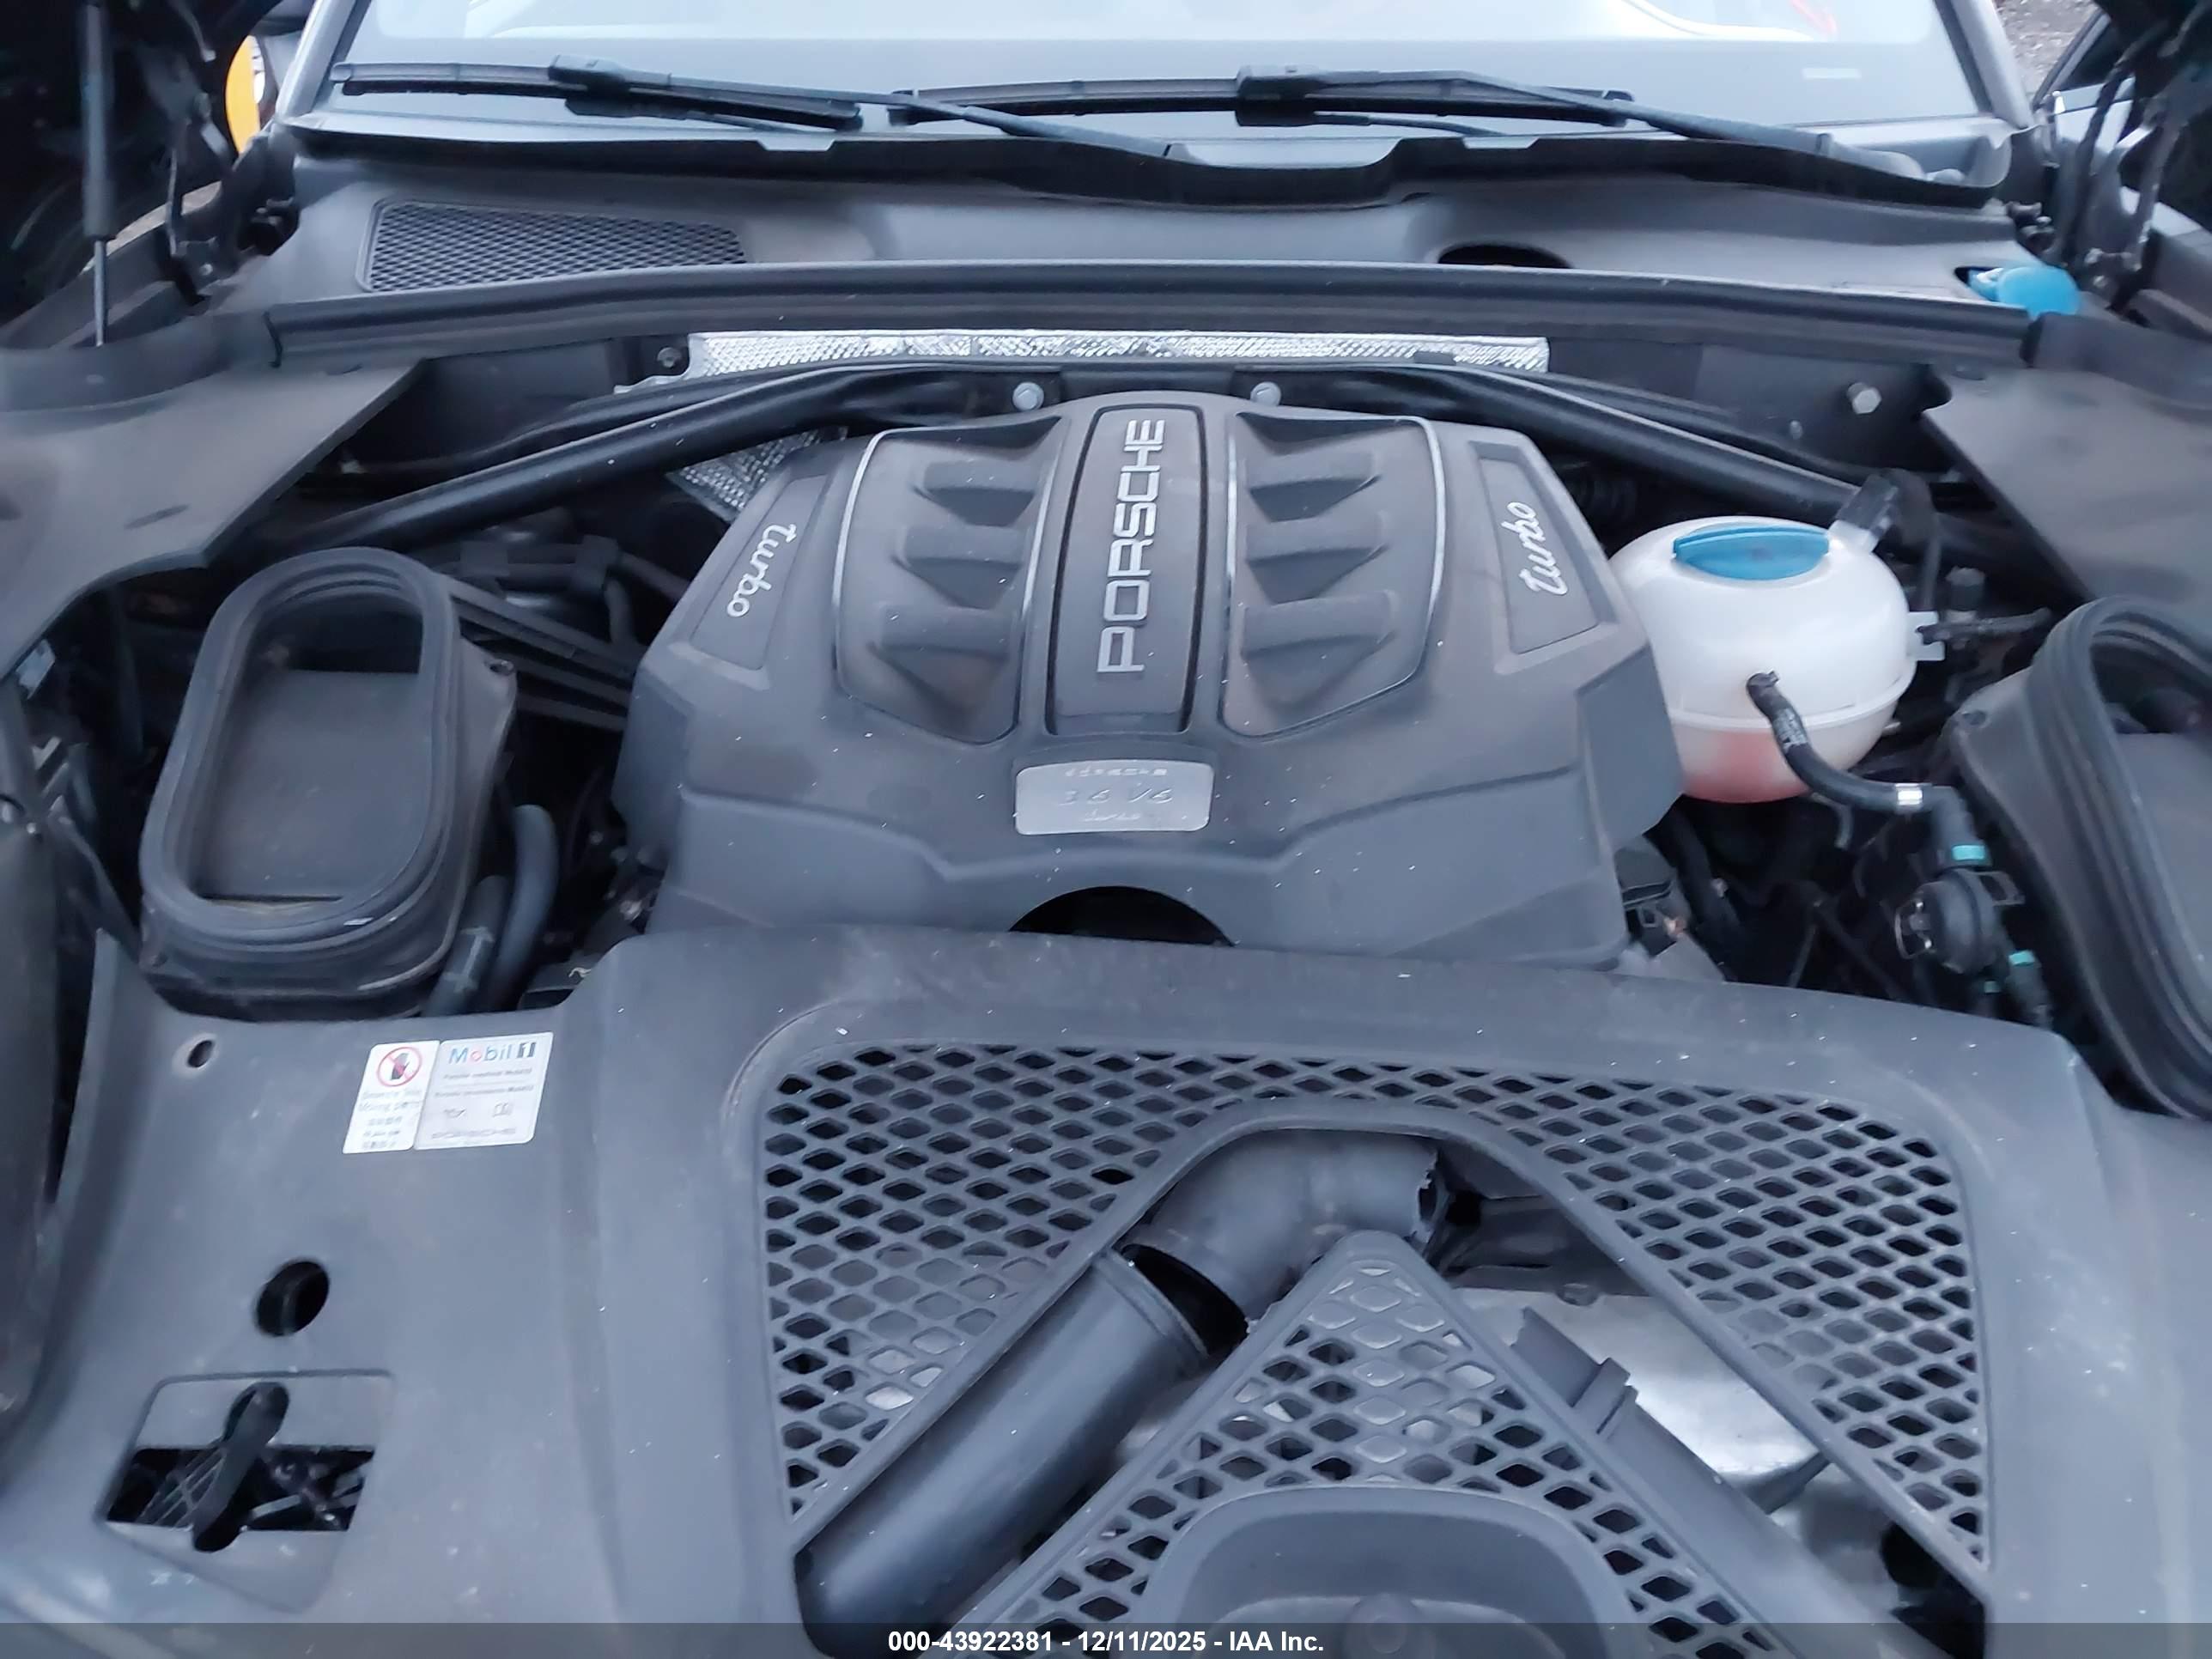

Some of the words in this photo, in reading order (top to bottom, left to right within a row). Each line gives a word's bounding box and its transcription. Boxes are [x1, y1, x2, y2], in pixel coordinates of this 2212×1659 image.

[726, 523, 797, 617] turbo
[1097, 419, 1165, 672] PORSCHE
[1501, 501, 1568, 595] turbo
[448, 1044, 514, 1065] Mobil
[517, 1042, 537, 1059] 1
